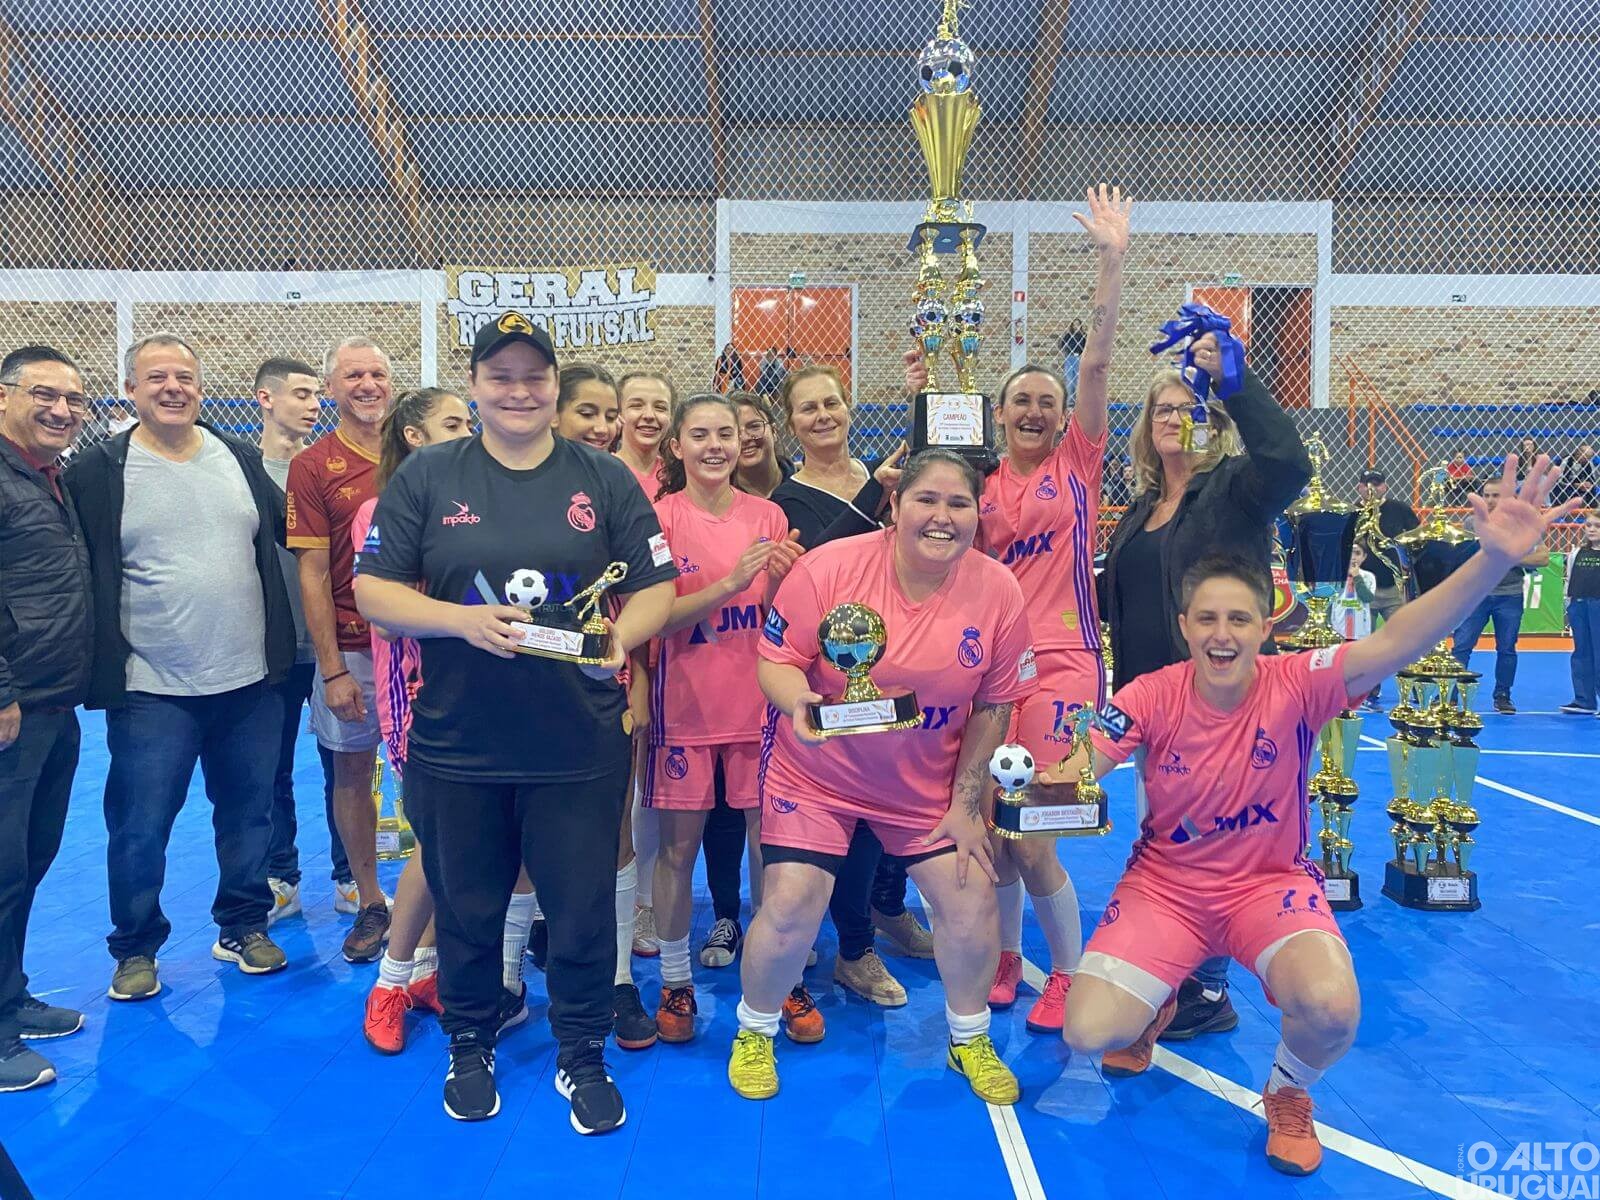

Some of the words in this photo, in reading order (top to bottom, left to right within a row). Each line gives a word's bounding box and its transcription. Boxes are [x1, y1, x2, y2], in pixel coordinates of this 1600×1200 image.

[457, 268, 651, 307] GERAL
[554, 307, 655, 348] FUTSAL
[716, 604, 763, 632] JM
